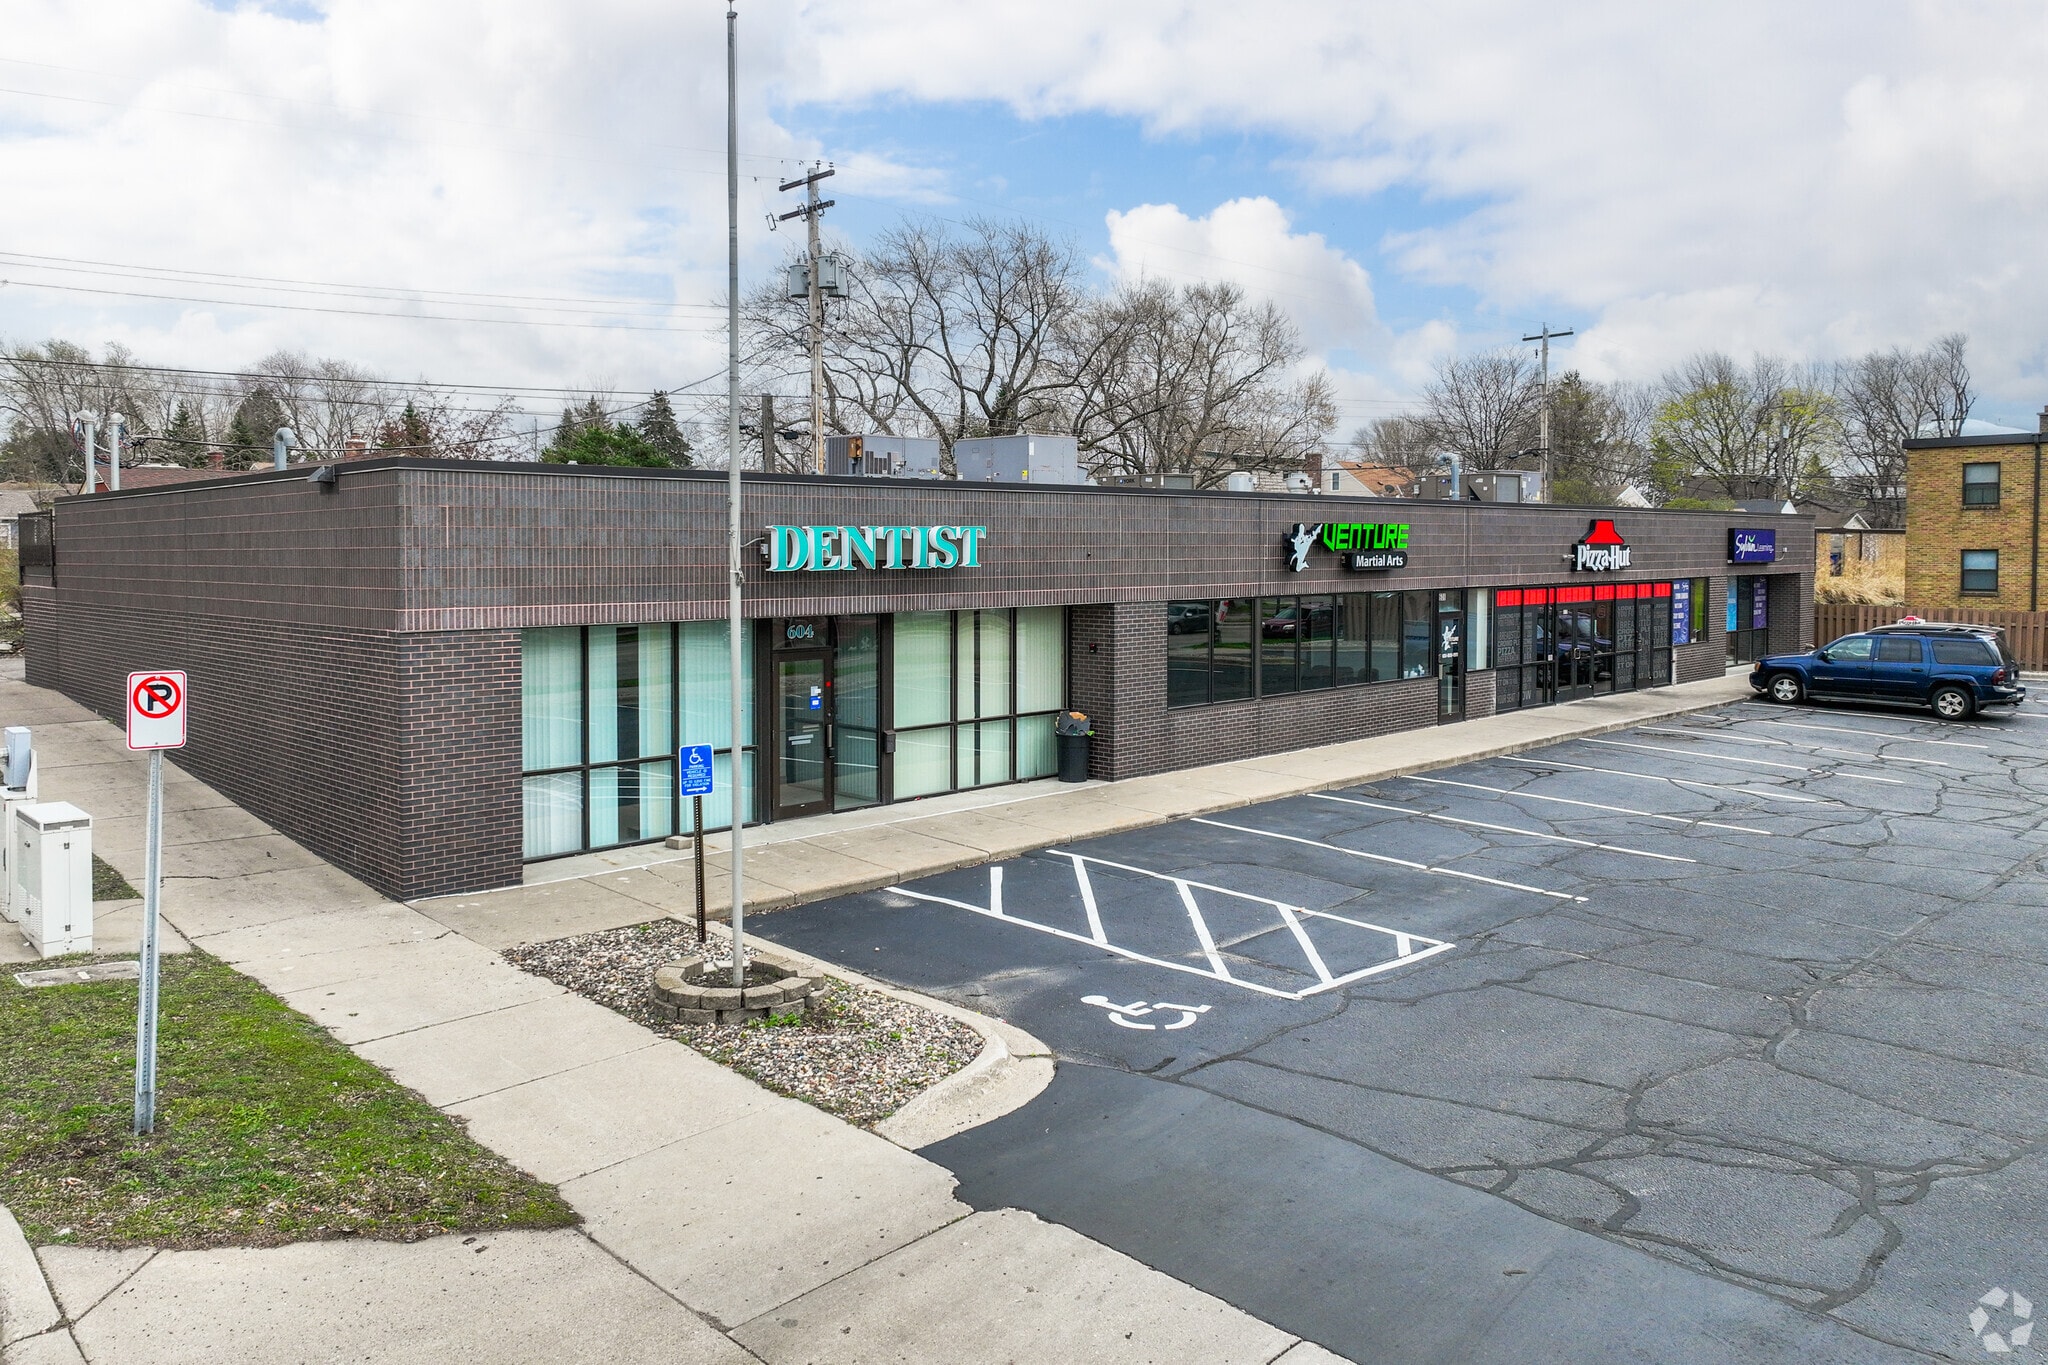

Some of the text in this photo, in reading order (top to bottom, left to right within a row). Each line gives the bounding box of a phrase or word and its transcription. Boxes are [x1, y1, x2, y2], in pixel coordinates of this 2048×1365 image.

[766, 525, 986, 571] DENTIST
[1323, 523, 1410, 552] VENTURE
[1735, 533, 1758, 559] Sylvan
[1356, 554, 1404, 567] Martial Arts
[1577, 544, 1631, 571] Pizza Hut
[786, 623, 814, 639] 604
